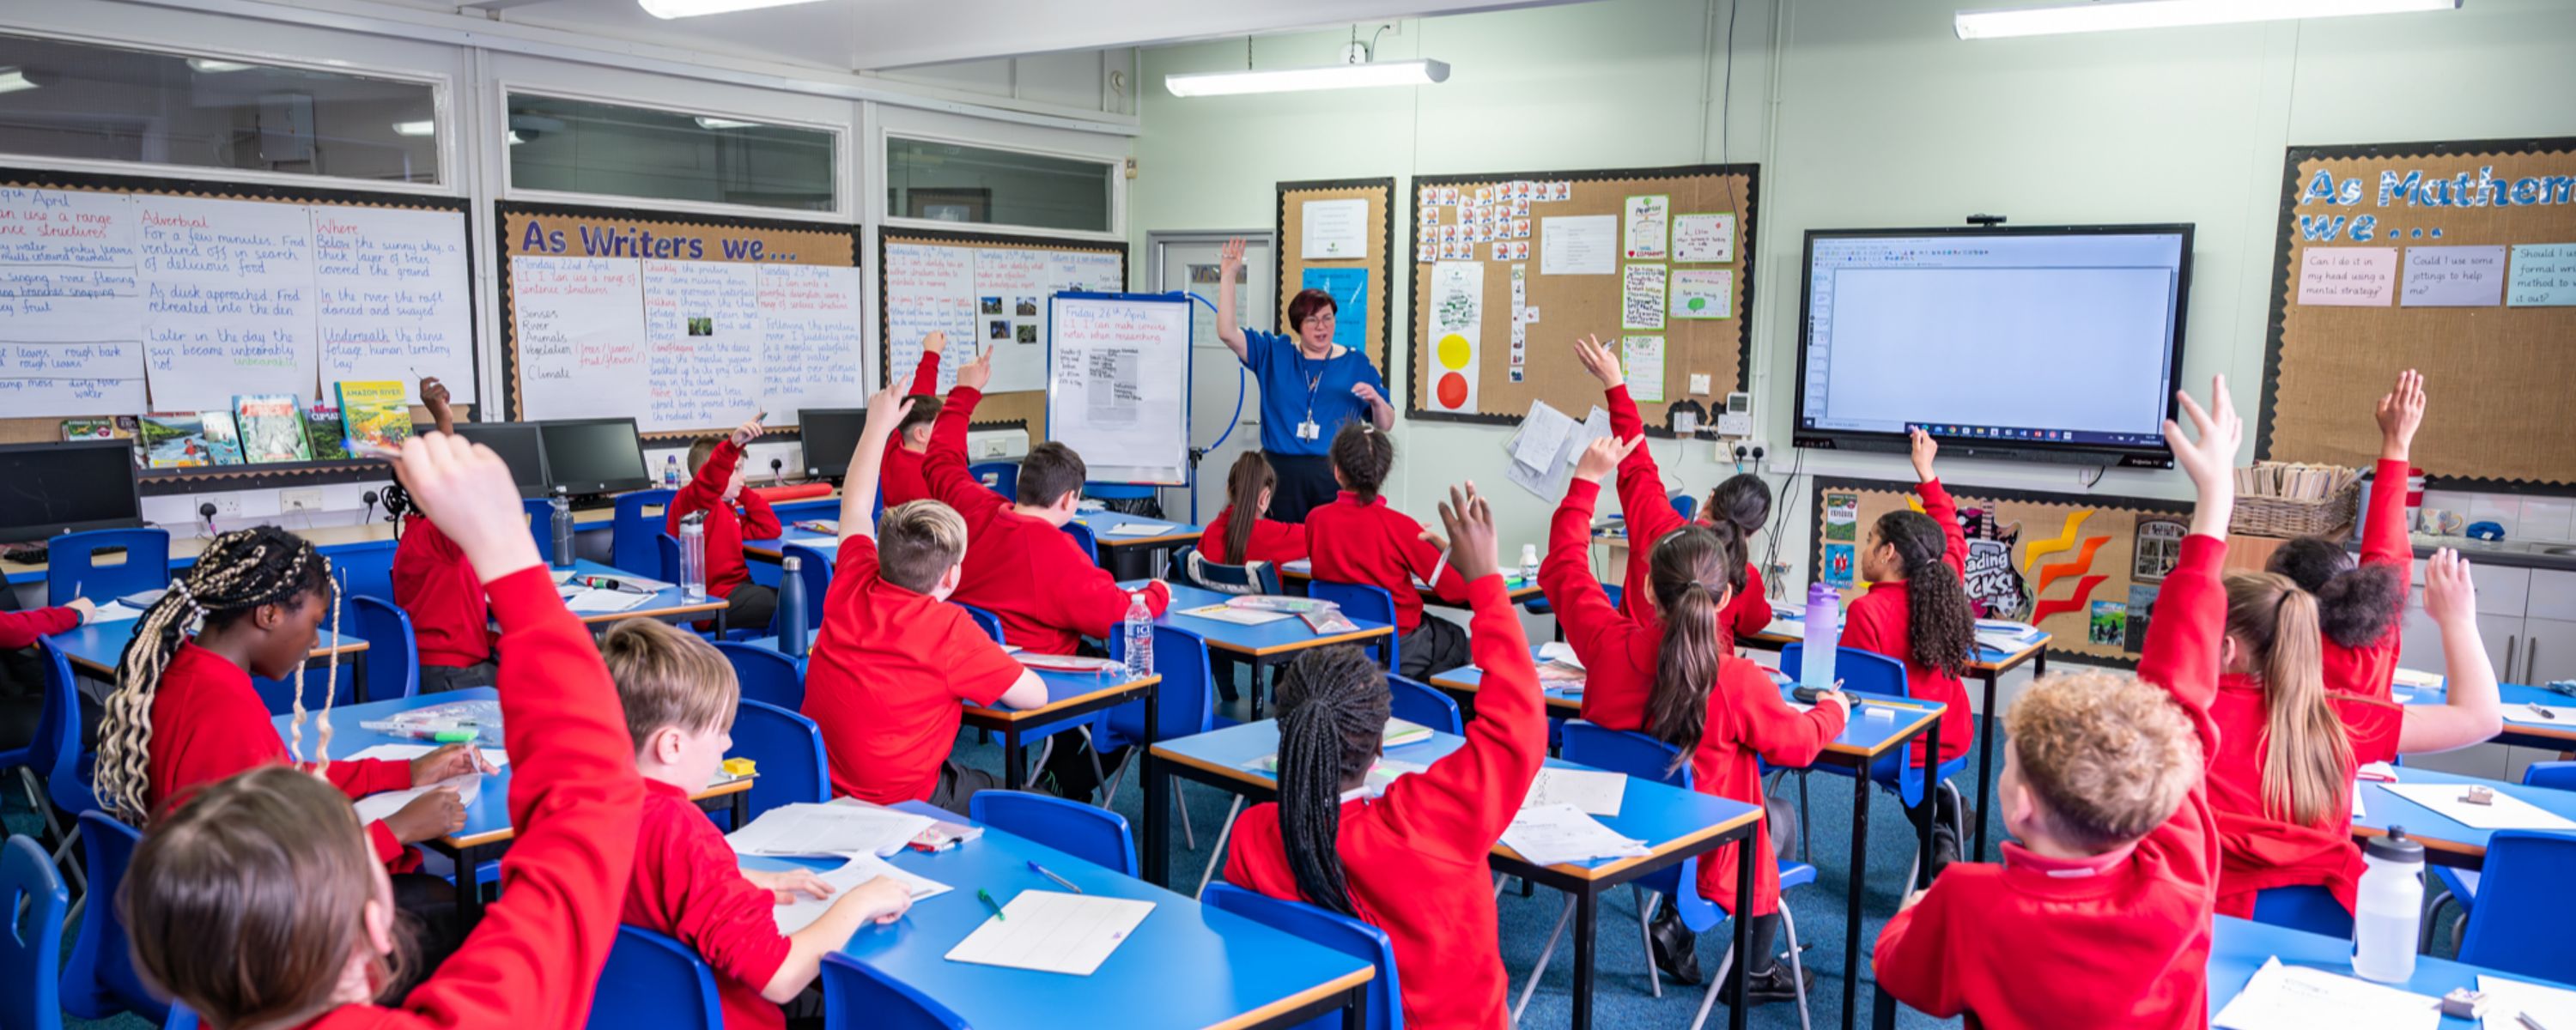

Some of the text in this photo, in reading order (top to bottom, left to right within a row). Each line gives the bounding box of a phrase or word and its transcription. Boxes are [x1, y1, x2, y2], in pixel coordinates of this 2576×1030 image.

[2301, 168, 2363, 205] As
[33, 190, 70, 209] April
[24, 211, 47, 221] use
[76, 214, 112, 228] range
[141, 209, 210, 228] Adverbial
[316, 218, 359, 234] Where
[38, 222, 106, 238] structures
[144, 226, 167, 240] For
[188, 227, 212, 245] few
[283, 235, 306, 247] Fred
[316, 234, 350, 249] Below
[355, 235, 374, 249] the
[382, 243, 416, 254] sunny
[522, 221, 566, 253] As
[579, 224, 703, 258] Writers
[141, 242, 298, 261] ventured off in search
[318, 249, 348, 262] thick
[356, 249, 384, 264] layer
[405, 254, 430, 264] trees
[2520, 248, 2555, 258] Should
[144, 256, 266, 276] of delicious food
[516, 258, 556, 274] Monday
[587, 259, 609, 272] April
[2310, 256, 2329, 265] Can
[2338, 257, 2349, 265] do
[2412, 255, 2440, 266] Could
[319, 264, 430, 281] covered the ground
[2307, 274, 2322, 282] my
[2325, 271, 2348, 280] head
[2351, 274, 2376, 282] using
[2410, 270, 2482, 283] jottings to help
[2518, 264, 2555, 276] formal
[2518, 276, 2569, 288] method to
[171, 283, 200, 297] dusk
[277, 288, 301, 300] Fred
[320, 288, 332, 302] In
[338, 287, 355, 302] the
[395, 291, 413, 303] the
[419, 290, 445, 305] raft
[2306, 286, 2383, 298] mental strategy?
[2409, 286, 2429, 295] me?
[2516, 293, 2549, 303] it out?
[149, 300, 295, 316] retreated into the den
[322, 304, 434, 321] danced and swayed
[520, 306, 558, 318] Senses
[1066, 306, 1094, 320] Friday
[1124, 308, 1147, 320] April
[522, 319, 550, 330] River
[149, 328, 294, 346] Later in the day the
[324, 328, 390, 343] Underneath
[395, 328, 412, 342] the
[525, 330, 568, 342] Animals
[16, 346, 121, 361] leaves rough bark
[150, 348, 175, 356] sun
[182, 343, 223, 356] became
[370, 345, 404, 355] human
[408, 342, 451, 357] territory
[525, 344, 572, 360] Vegetation
[20, 360, 82, 370] rough leaves
[153, 355, 173, 370] hot
[333, 358, 353, 373] lay
[528, 364, 570, 379] Climate
[1966, 552, 2008, 572] ading
[1965, 573, 2014, 598] CKS!
